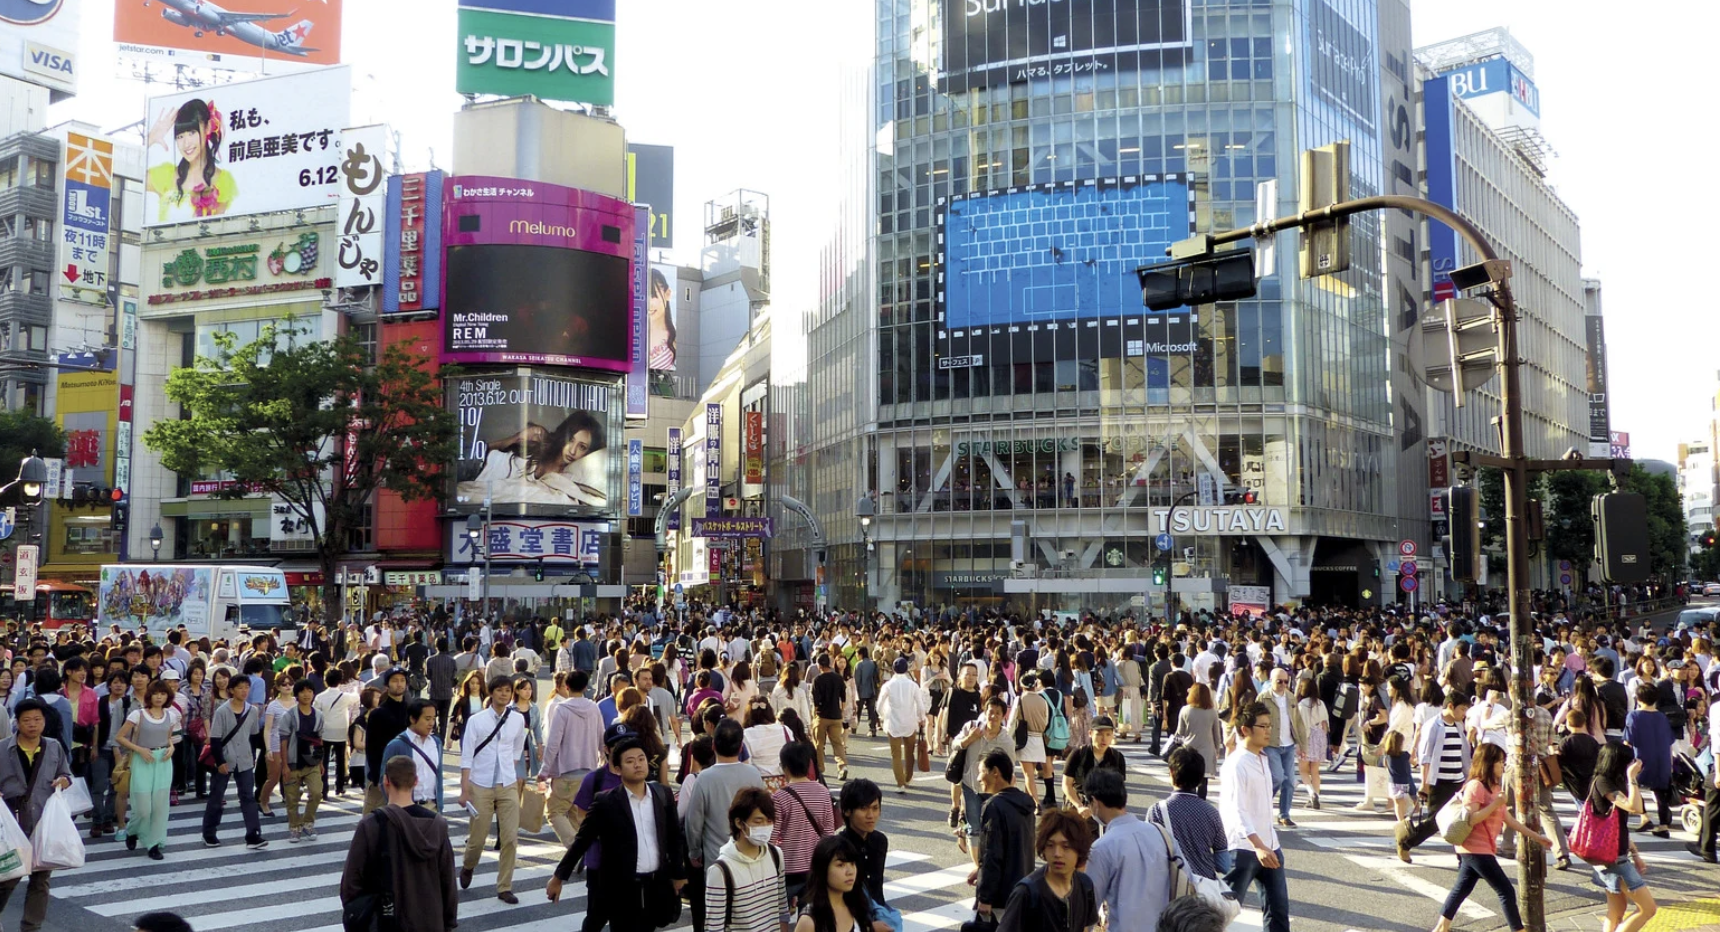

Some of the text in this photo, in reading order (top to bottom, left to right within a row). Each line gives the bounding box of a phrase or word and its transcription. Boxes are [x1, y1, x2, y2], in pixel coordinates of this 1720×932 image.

[119, 44, 164, 56] jetstar.com
[465, 35, 608, 76] サロンパス
[31, 49, 73, 74] VISA
[1017, 61, 1108, 79] ハマる、タブレット。
[229, 108, 270, 131] 私も、
[299, 165, 338, 187] 6.12
[463, 188, 534, 197] わかさ生活 チャンネル
[68, 213, 106, 227] ブックファースト
[338, 142, 382, 281] もんじゃ
[65, 229, 106, 249] 夜11時
[399, 178, 420, 304] 三千里薬品
[72, 246, 97, 263] まで
[83, 269, 105, 286] 地下
[204, 254, 257, 284] 西村
[453, 312, 508, 322] Mr.Children
[453, 327, 486, 339] REM
[1146, 342, 1197, 353] Microsoft
[459, 379, 501, 391] 4th Single
[459, 389, 534, 407] 2013.6.12 OUT
[458, 406, 486, 461] 1%
[707, 407, 720, 479] 洋服の青山
[958, 436, 1080, 456] STARBUCKS
[631, 444, 642, 511] 大盛堂商事ビル
[669, 438, 681, 500] 洋服の青
[1154, 508, 1286, 532] TSUTAYA
[458, 527, 600, 555] 大盛堂書店
[18, 551, 29, 594] 道玄坂
[388, 573, 437, 584] 三千里薬品
[944, 575, 992, 583] STARBUCKS
